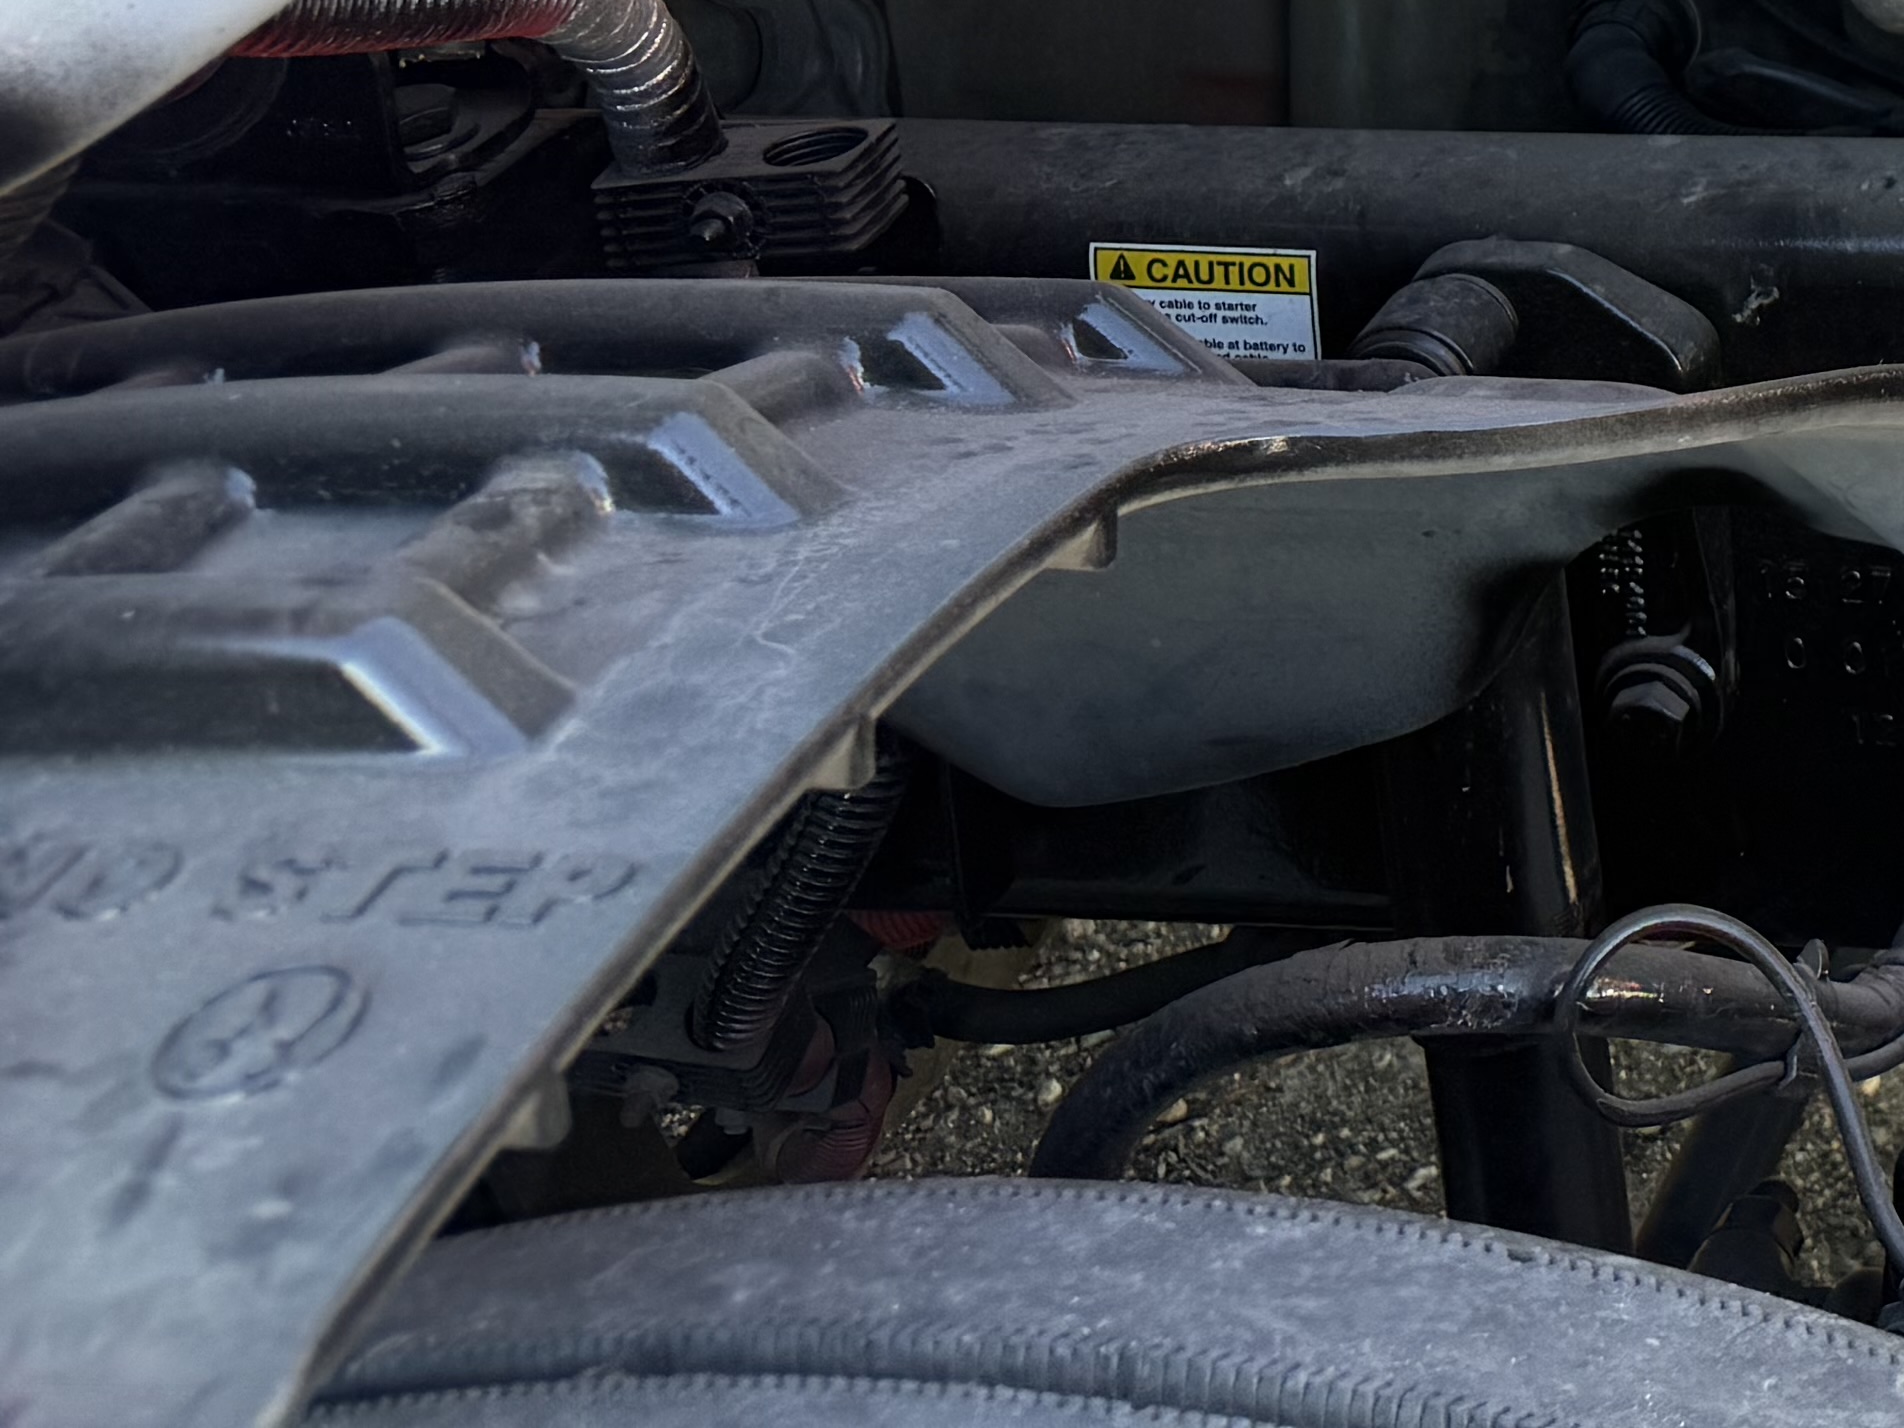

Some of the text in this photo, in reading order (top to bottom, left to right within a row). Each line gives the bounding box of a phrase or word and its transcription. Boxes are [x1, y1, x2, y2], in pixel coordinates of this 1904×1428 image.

[1146, 258, 1296, 288] CAUTION
[1159, 299, 1194, 310] cable
[1198, 300, 1211, 311] to
[1214, 301, 1257, 312] starter
[1175, 313, 1218, 324] cut-off
[1221, 315, 1268, 326] switch.
[1227, 339, 1306, 354] at battery to
[209, 845, 643, 930] STEP
